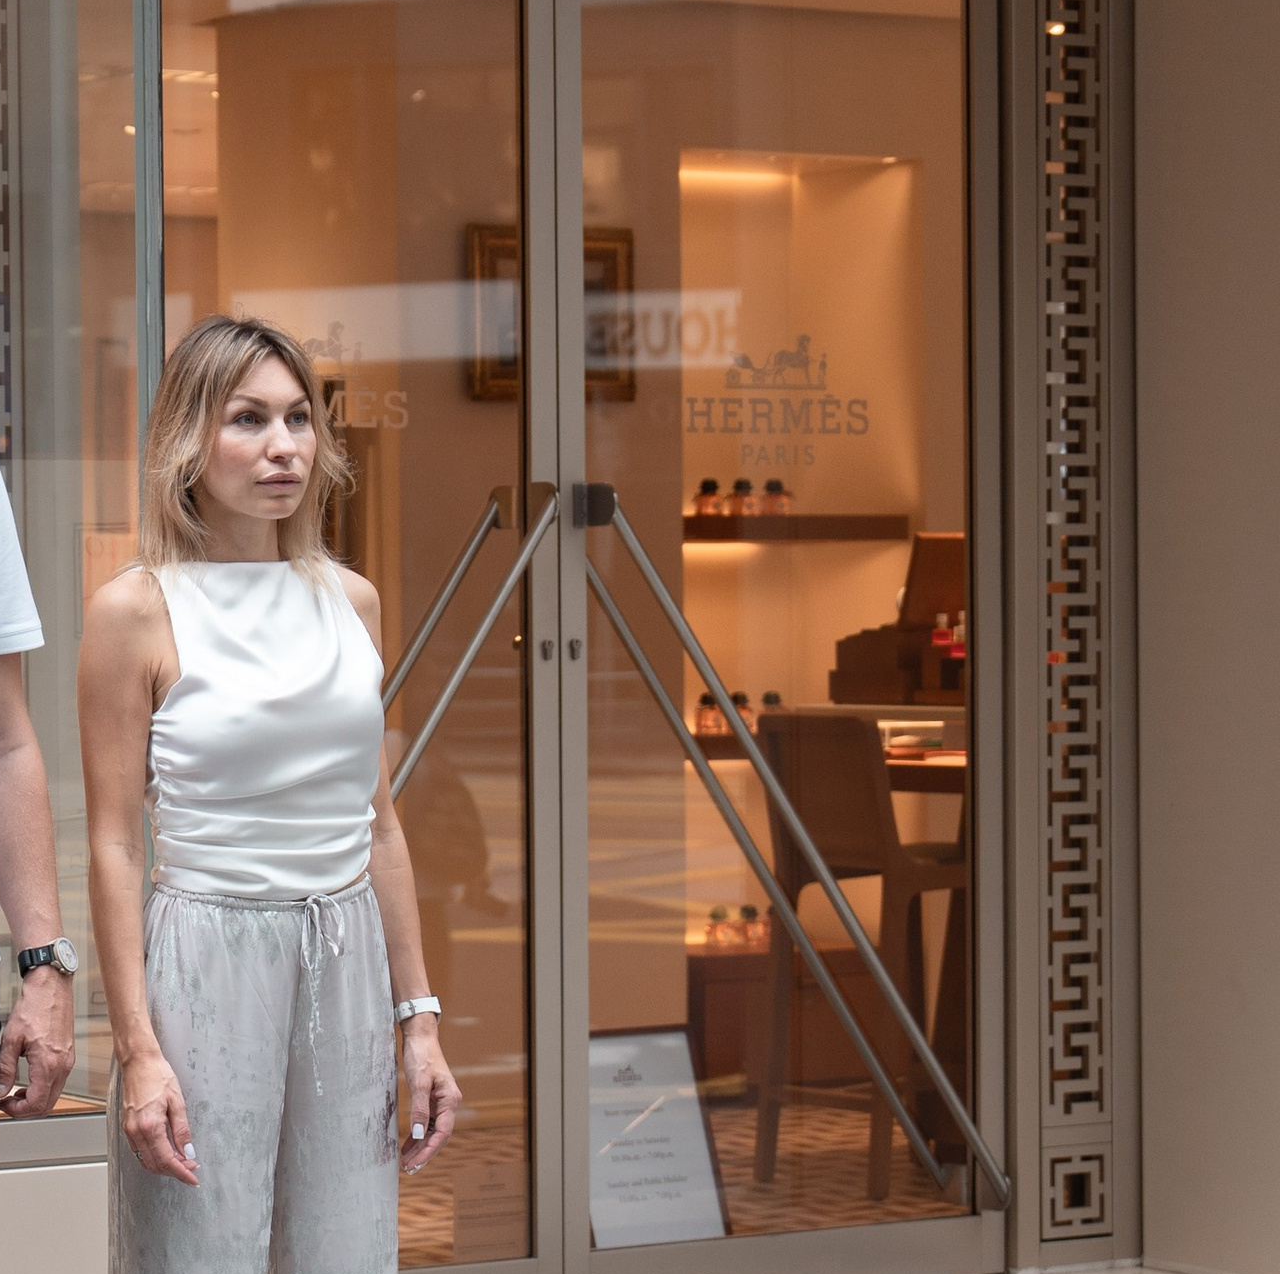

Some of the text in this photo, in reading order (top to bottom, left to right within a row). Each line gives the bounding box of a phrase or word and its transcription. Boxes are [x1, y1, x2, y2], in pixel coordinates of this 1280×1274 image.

[323, 386, 410, 429] MÈS
[686, 393, 870, 436] HERMÈS
[741, 443, 816, 466] PARIS
